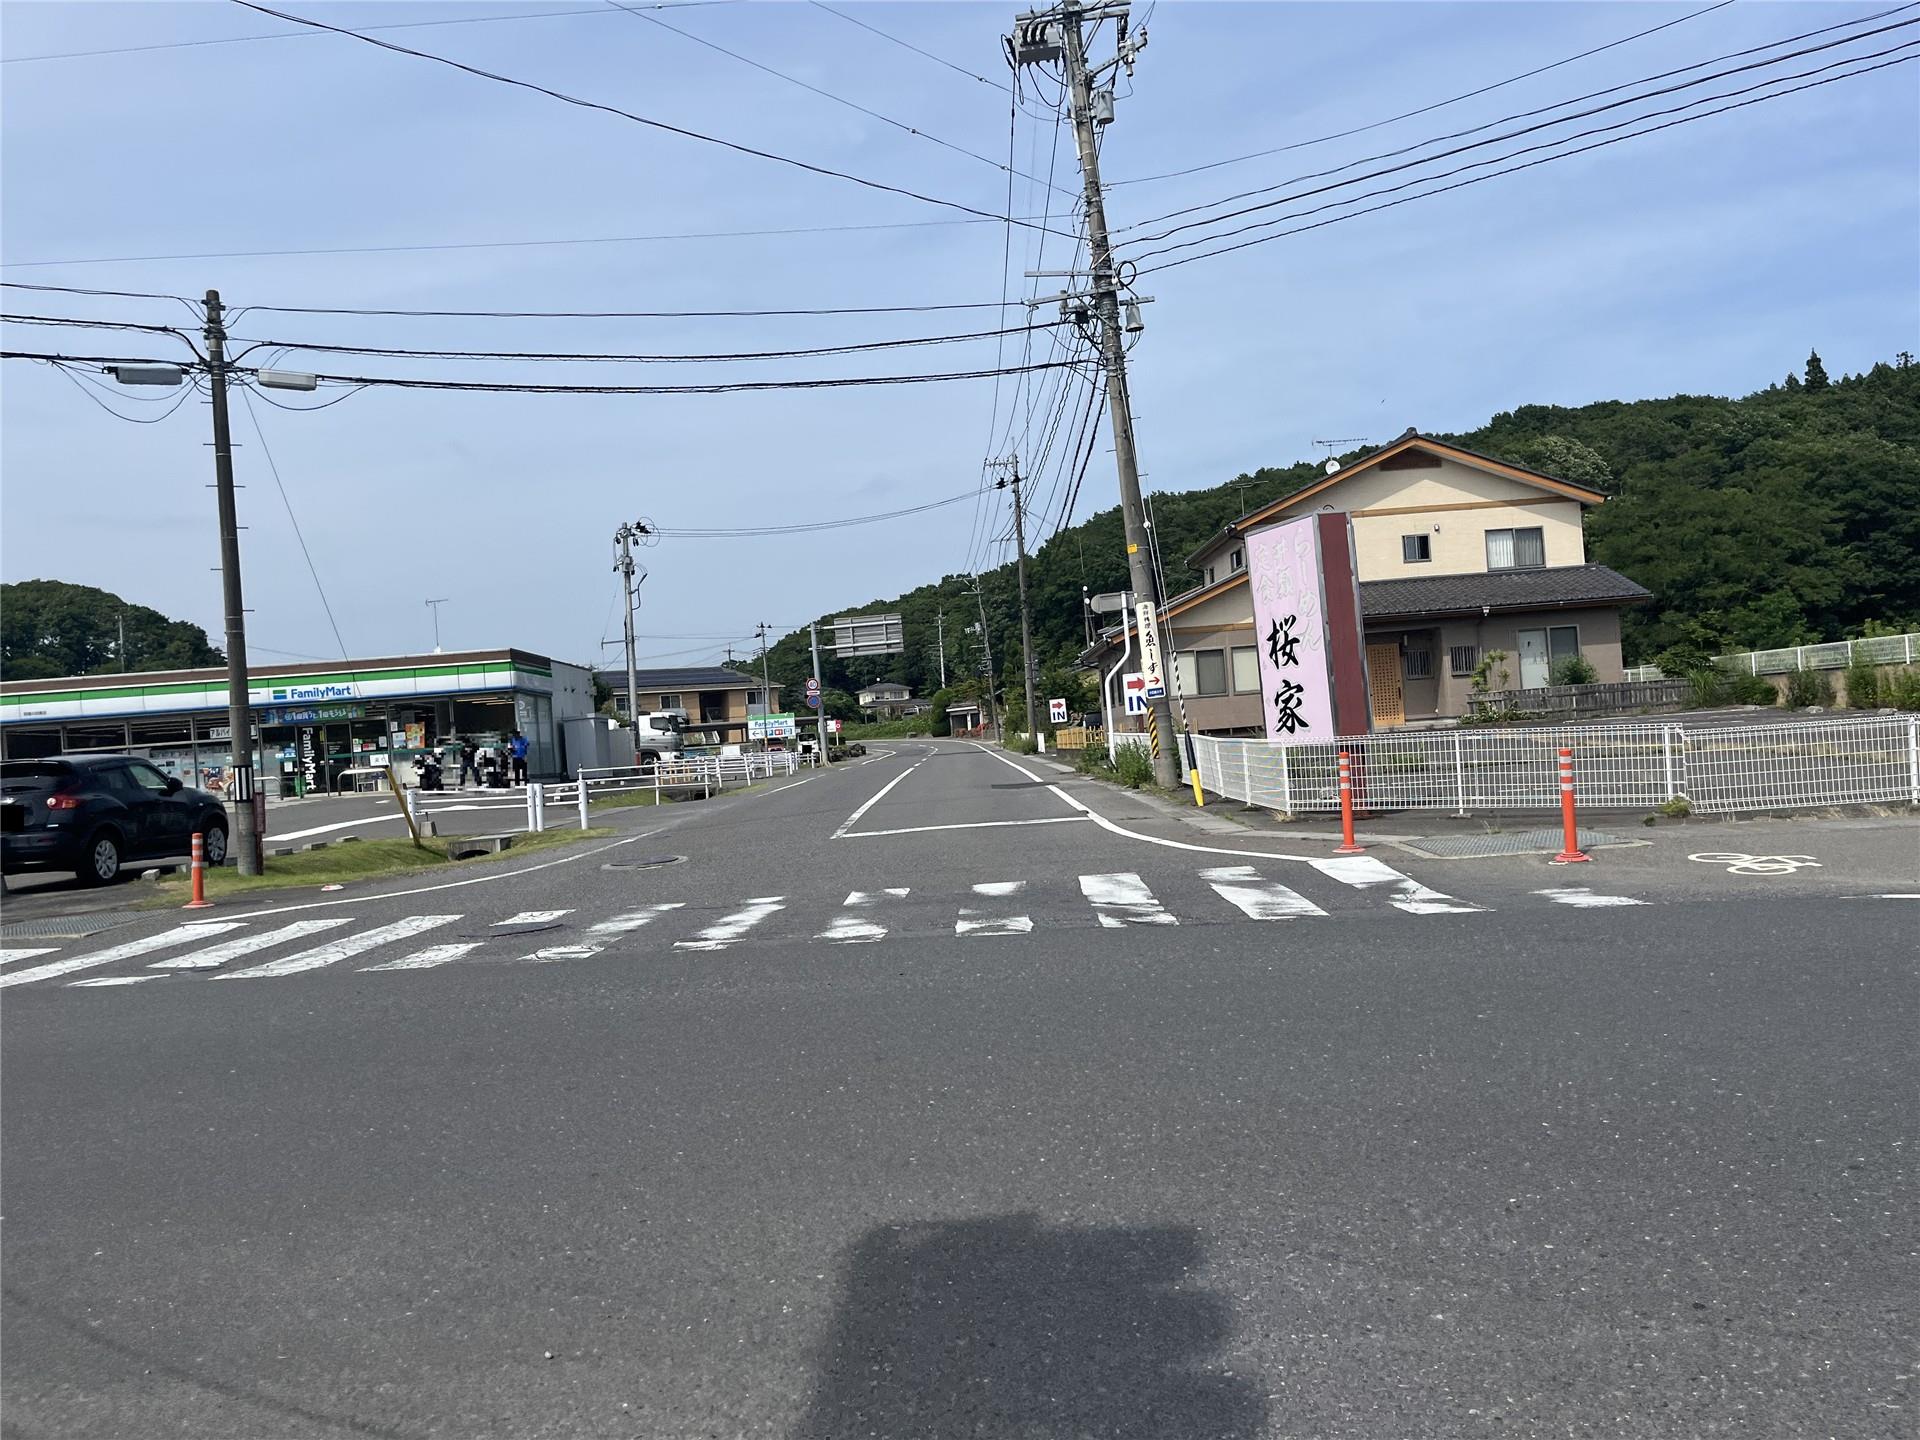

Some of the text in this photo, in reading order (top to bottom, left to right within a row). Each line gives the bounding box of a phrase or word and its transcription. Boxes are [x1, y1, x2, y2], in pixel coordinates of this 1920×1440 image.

[1266, 614, 1310, 735] 桜家
[291, 685, 352, 699] FamilyMart
[1128, 695, 1149, 712] IN
[1052, 711, 1066, 721] IN
[302, 727, 317, 791] FamilyMart
